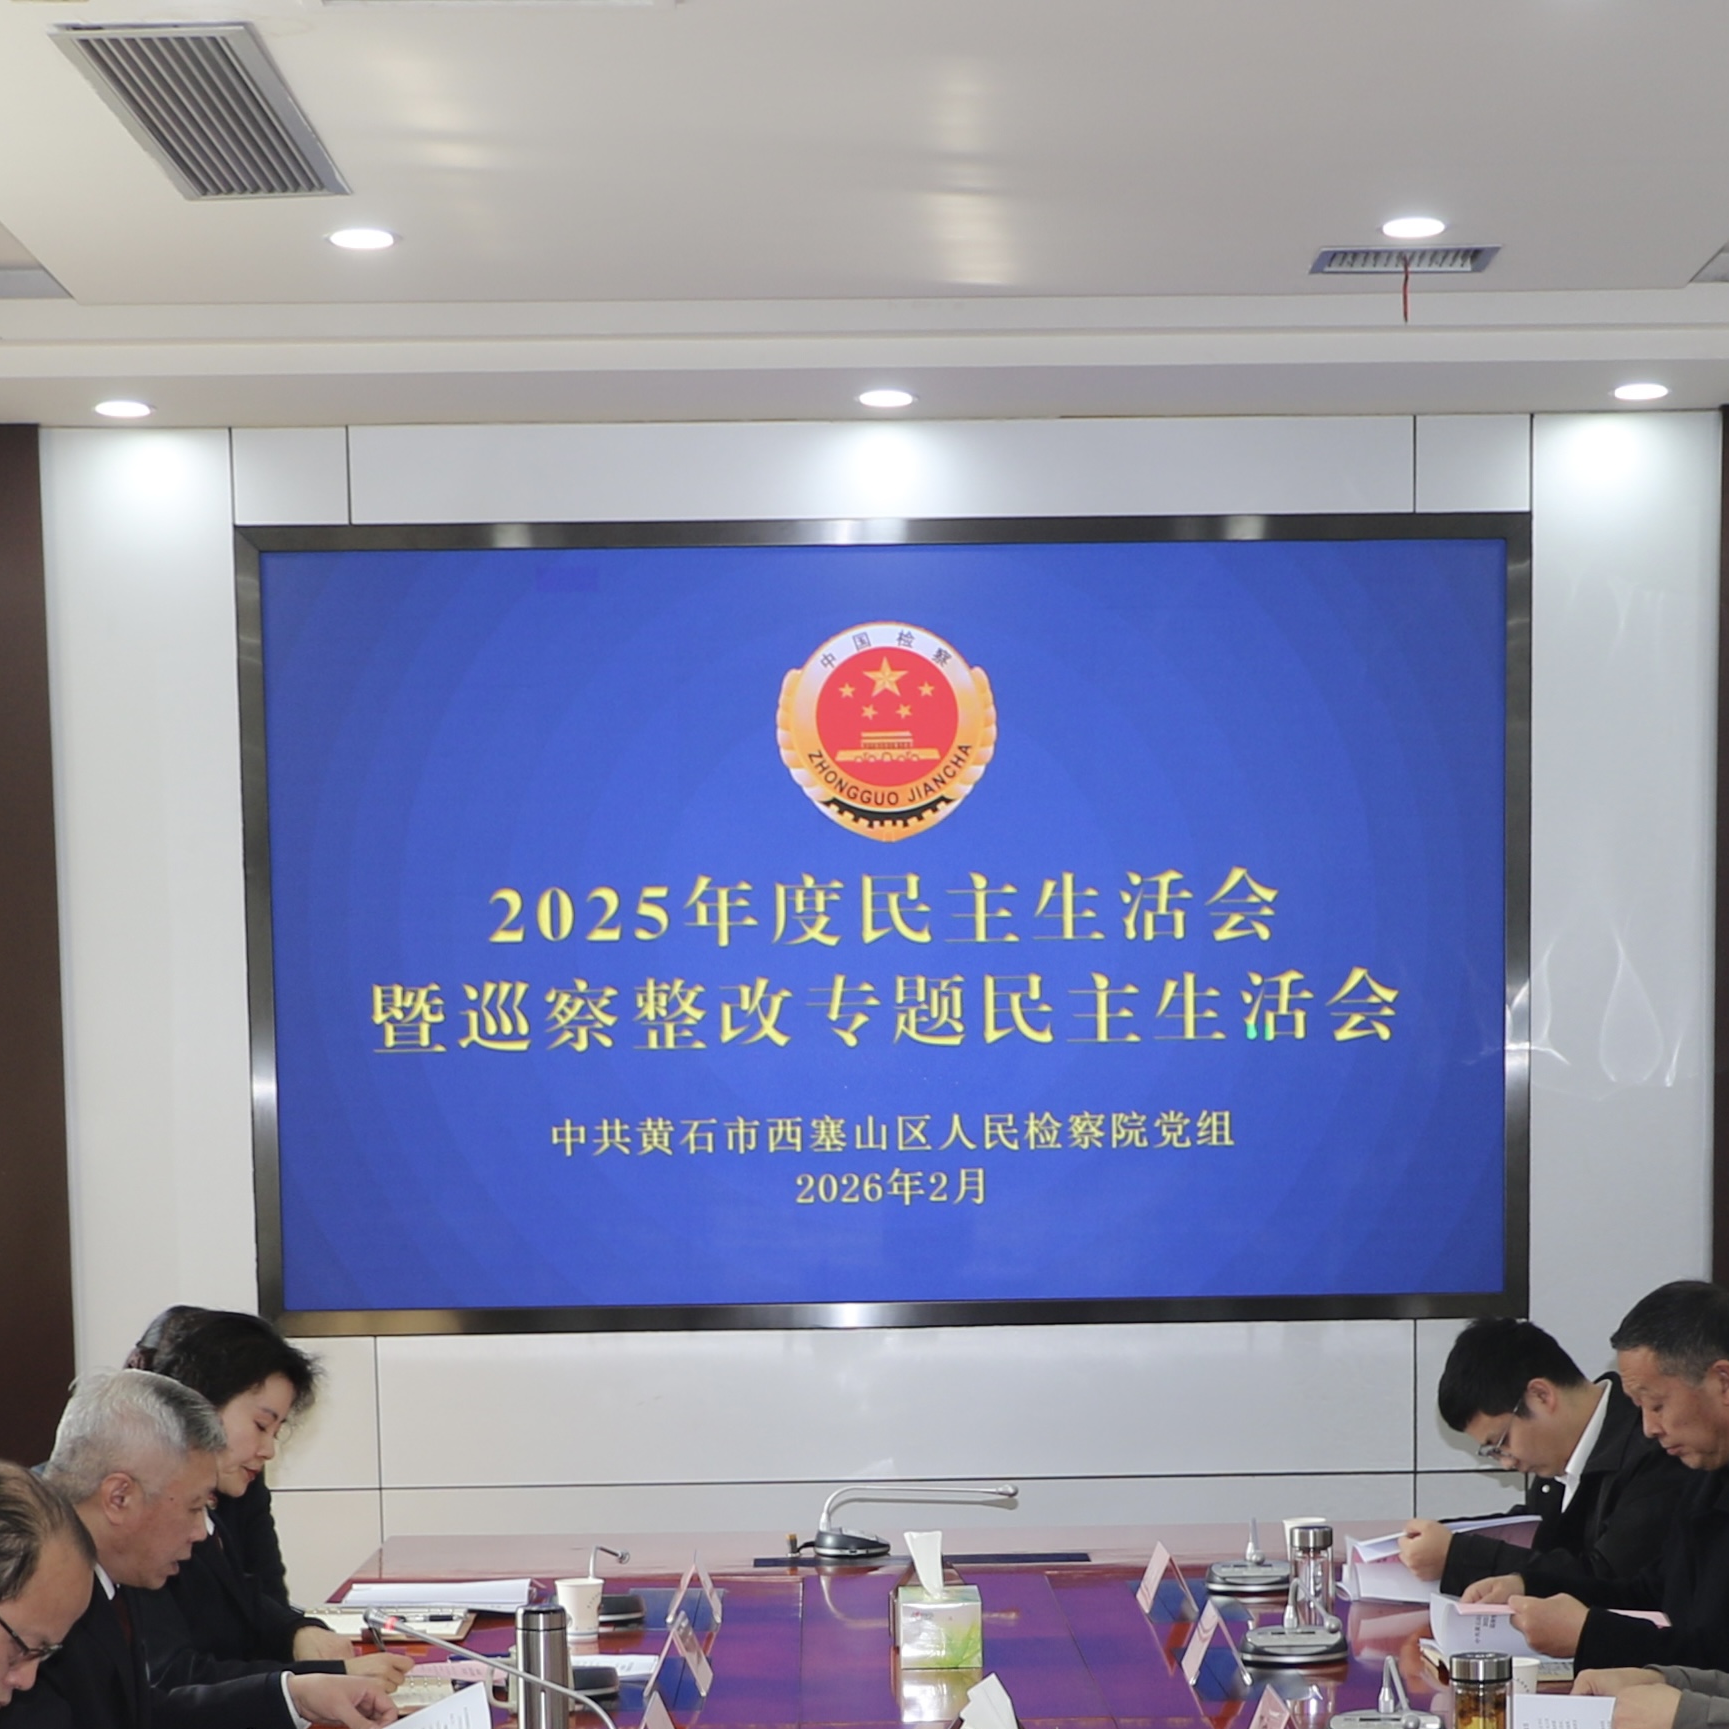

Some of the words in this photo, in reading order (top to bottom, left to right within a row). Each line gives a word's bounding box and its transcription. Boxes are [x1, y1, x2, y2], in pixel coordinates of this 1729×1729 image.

[821, 629, 953, 669] 中国检察
[808, 749, 899, 806] ZHONGGUO
[908, 743, 973, 803] JIANCHA
[488, 866, 1279, 946] 2025年度民主生活会
[371, 966, 1400, 1054] 暨巡察整改专题民主生活会
[551, 1110, 1235, 1157] 中共黄石市西塞山区人民检察院党组
[796, 1168, 986, 1206] 2026年2月
